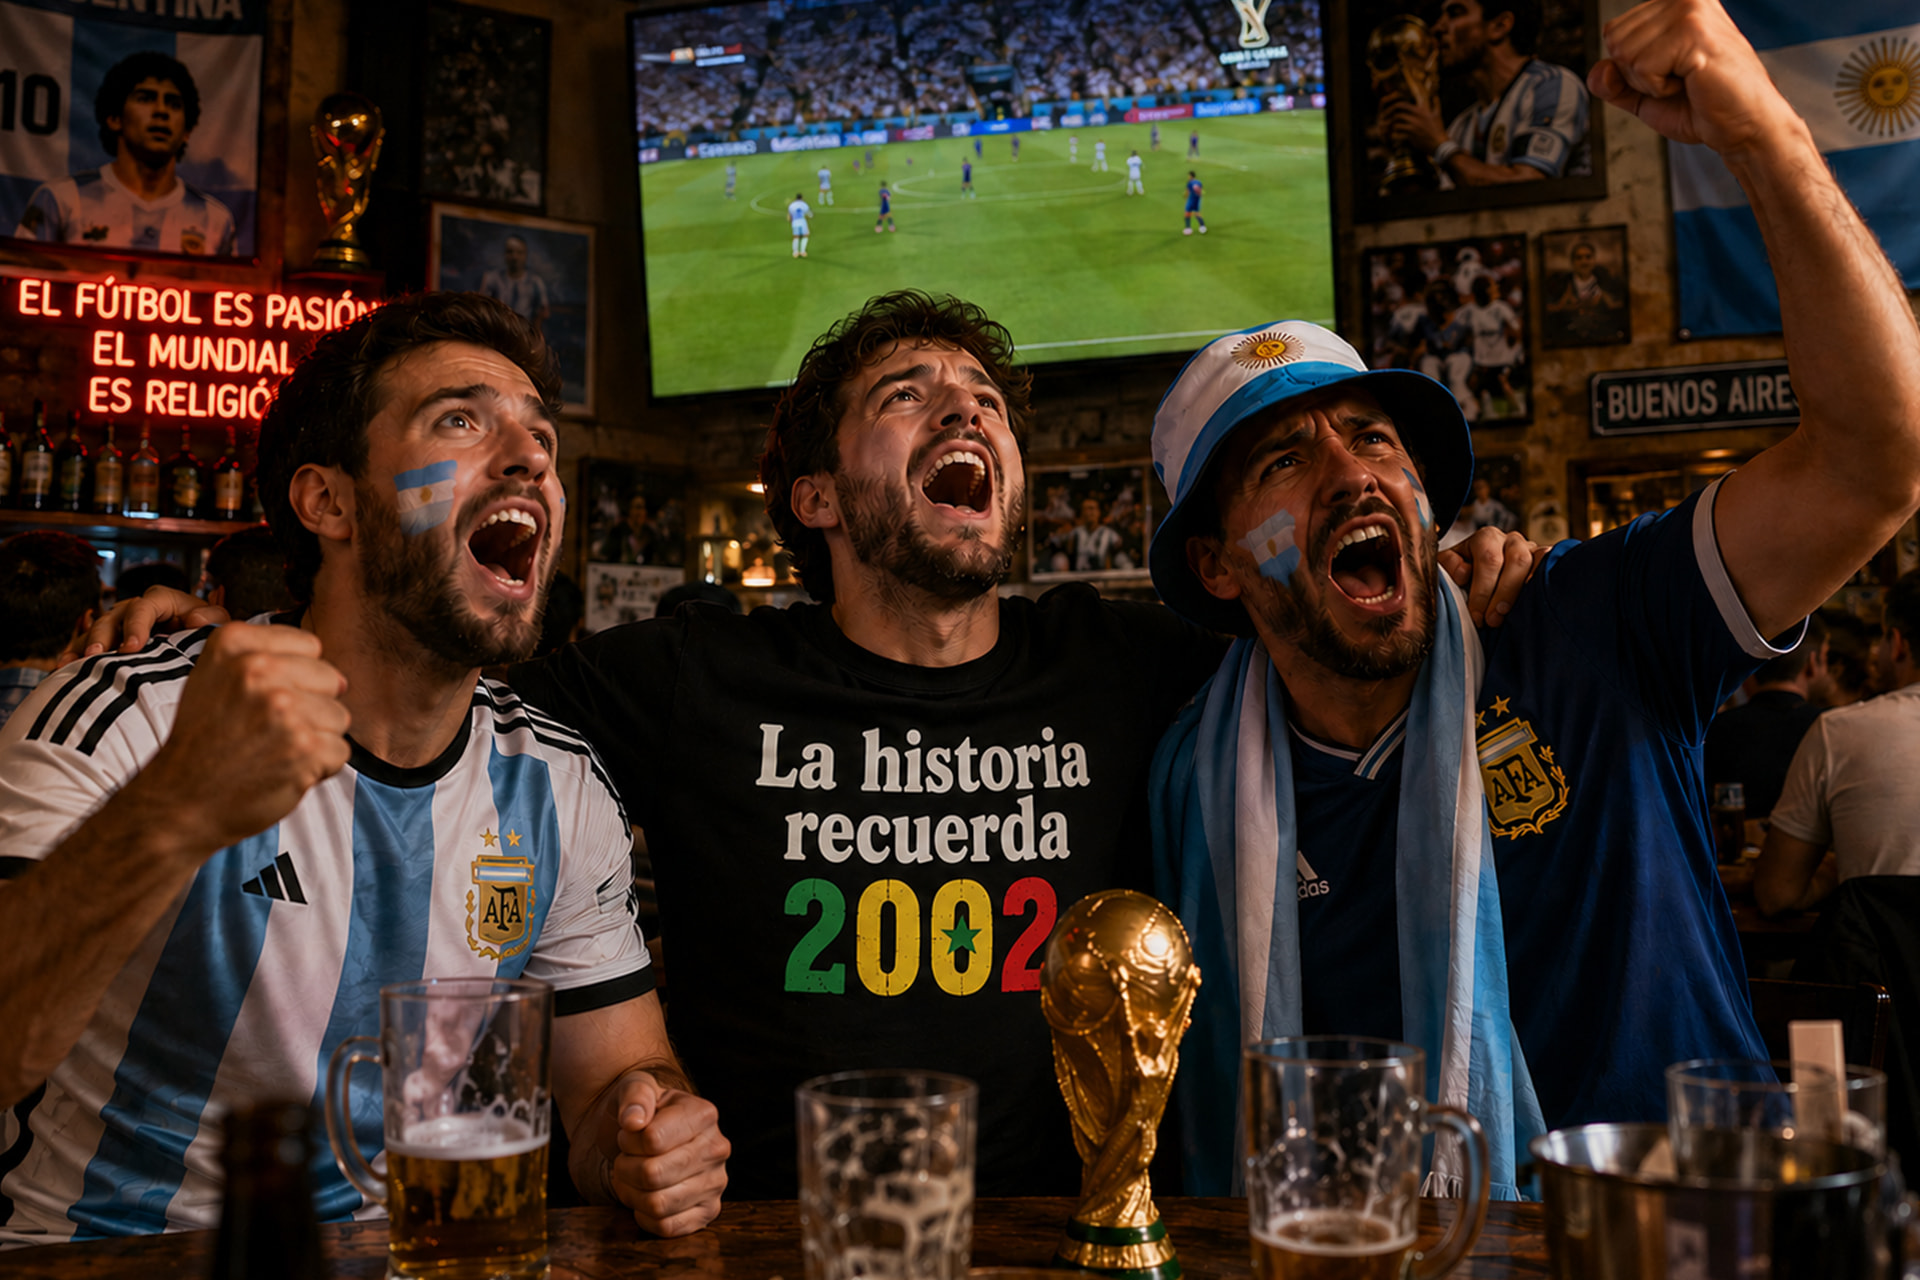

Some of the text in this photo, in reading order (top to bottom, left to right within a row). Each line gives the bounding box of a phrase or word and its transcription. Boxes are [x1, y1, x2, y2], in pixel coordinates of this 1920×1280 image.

[0, 69, 62, 136] 10
[19, 278, 62, 317] EL
[75, 275, 203, 325] FÚTBOL
[213, 290, 254, 328] ES
[93, 330, 294, 375] EL MUNDIAL
[88, 376, 273, 420] ES RELIGIÓ
[1607, 373, 1799, 422] BUENOS AIRE
[755, 723, 1091, 793] La historia
[1486, 753, 1547, 808] AFA
[784, 794, 1071, 864] recuerda
[482, 885, 522, 931] AFA
[1297, 879, 1330, 899] das
[784, 876, 1057, 996] 2002
